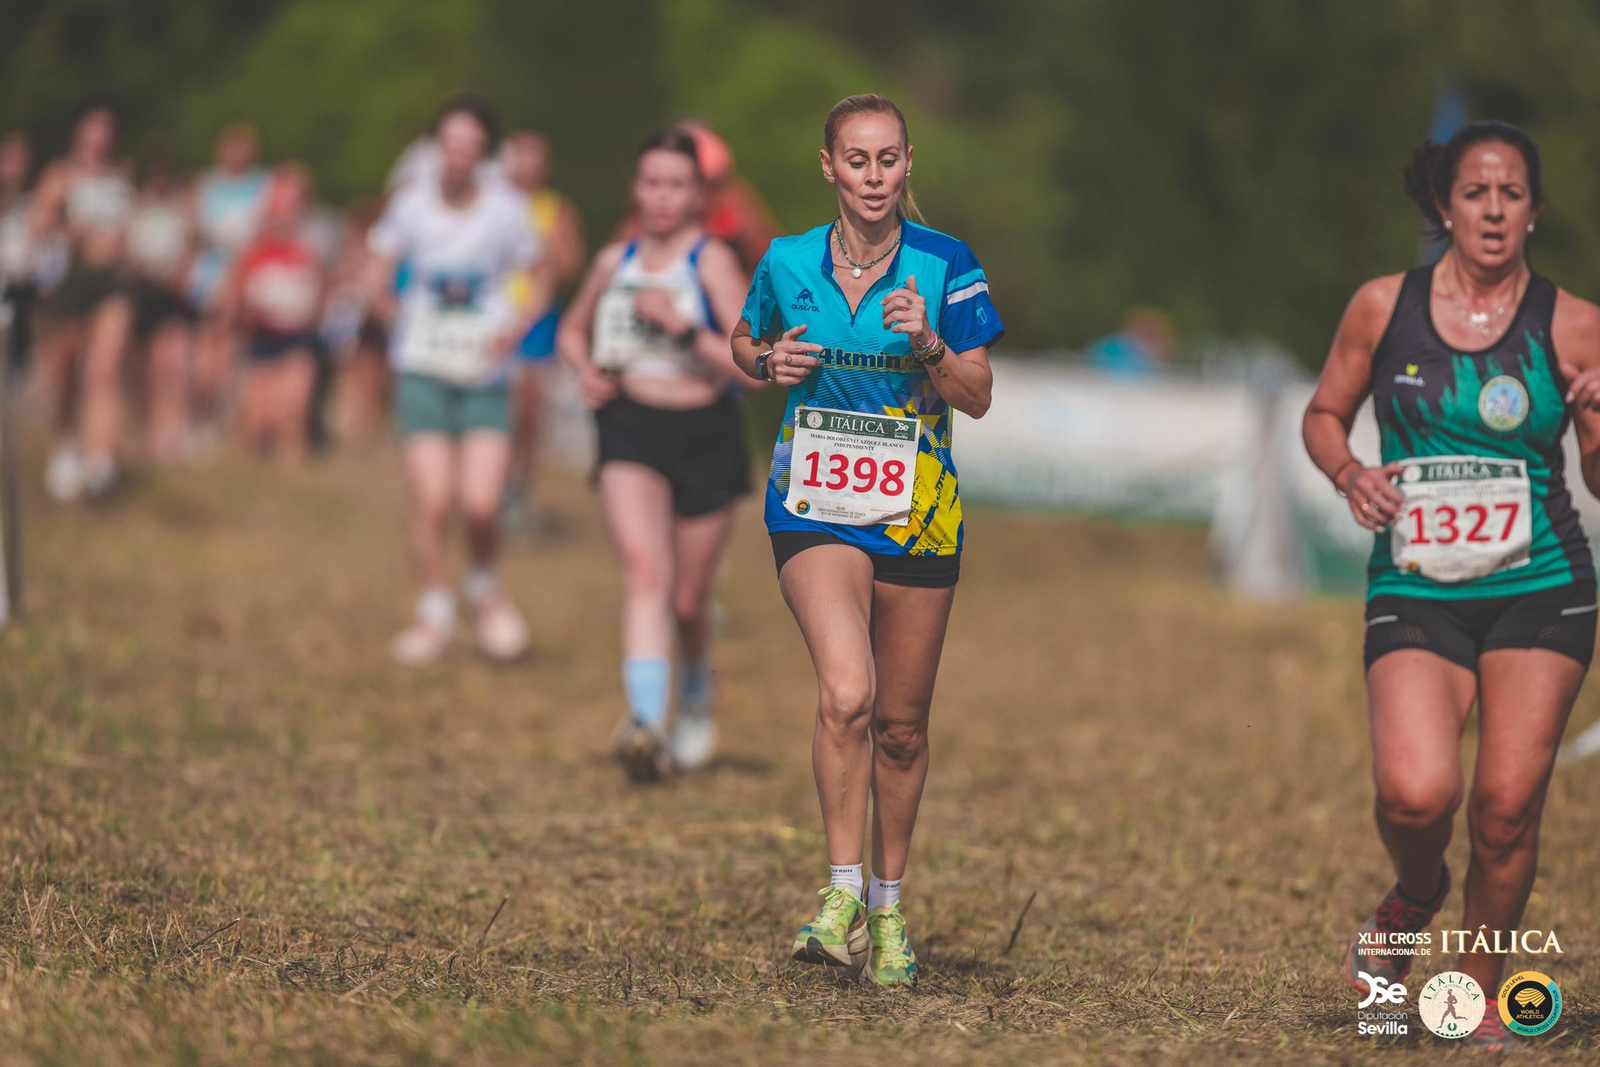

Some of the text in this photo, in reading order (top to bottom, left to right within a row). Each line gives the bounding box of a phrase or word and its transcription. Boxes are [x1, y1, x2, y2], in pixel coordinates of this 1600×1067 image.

[830, 413, 885, 434] ITÁLICA
[833, 442, 875, 451] INDEPENDIENTE
[882, 441, 904, 449] BLANCO
[803, 451, 906, 496] 1398
[1408, 501, 1520, 545] 1327
